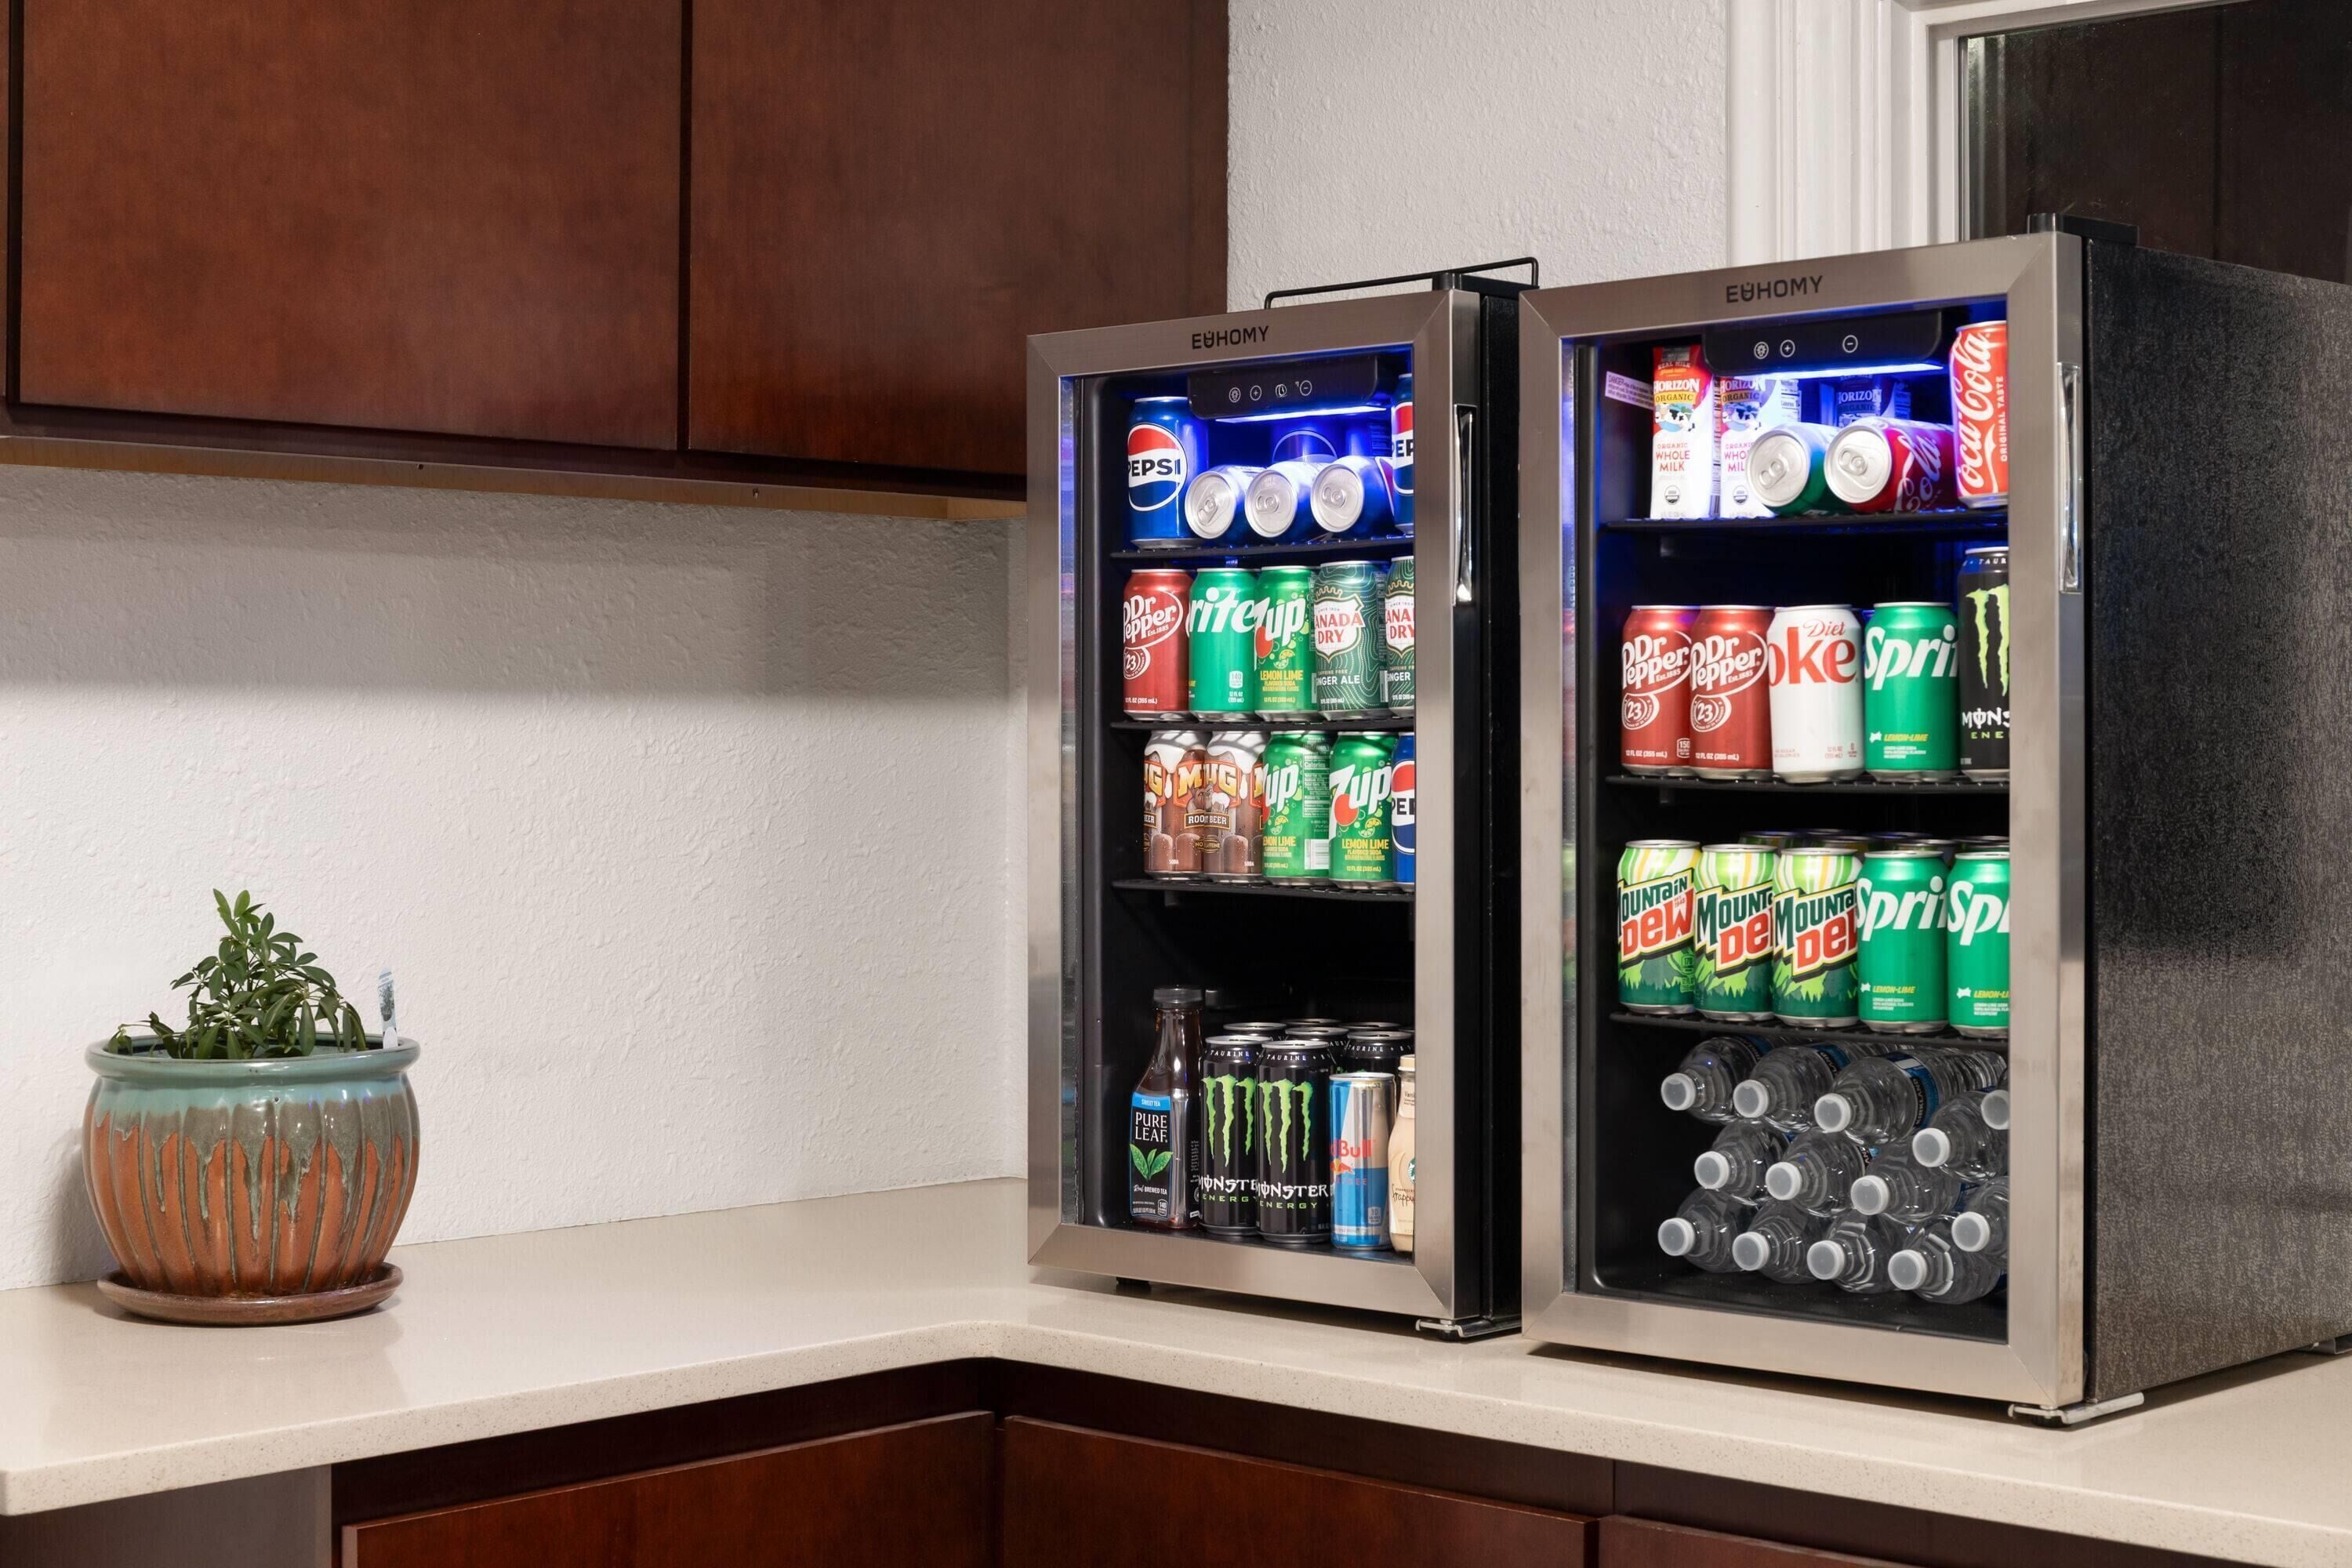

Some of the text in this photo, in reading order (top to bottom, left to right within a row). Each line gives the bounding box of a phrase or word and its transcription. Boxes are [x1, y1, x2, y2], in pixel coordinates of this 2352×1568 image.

[1653, 378, 1700, 394] HORIZON
[1655, 394, 1693, 403] ORGANIC
[1995, 376, 2008, 463] ORIGINAL TASTE
[1656, 450, 1691, 461] WHOLE
[1659, 461, 1685, 472] MILK
[1131, 595, 1156, 621] Dr
[1802, 619, 1846, 637] Diet
[1318, 630, 1345, 644] DRY
[1635, 635, 1668, 662] Dr
[1705, 635, 1740, 665] Dr
[1127, 654, 1136, 671] 23
[1622, 642, 1690, 691] Pepper
[1691, 642, 1762, 691] Pepper
[1261, 670, 1303, 681] LEMON LIME
[1341, 674, 1360, 684] ALE
[1628, 701, 1642, 720] 23
[1697, 702, 1714, 723] 23
[1279, 837, 1296, 847] LIME
[1341, 839, 1389, 849] LEMON LIME
[1135, 1112, 1167, 1129] PURE
[1135, 1127, 1167, 1143] LEAF
[1144, 1185, 1160, 1194] BREWED
[1260, 1200, 1317, 1209] ENERGY
